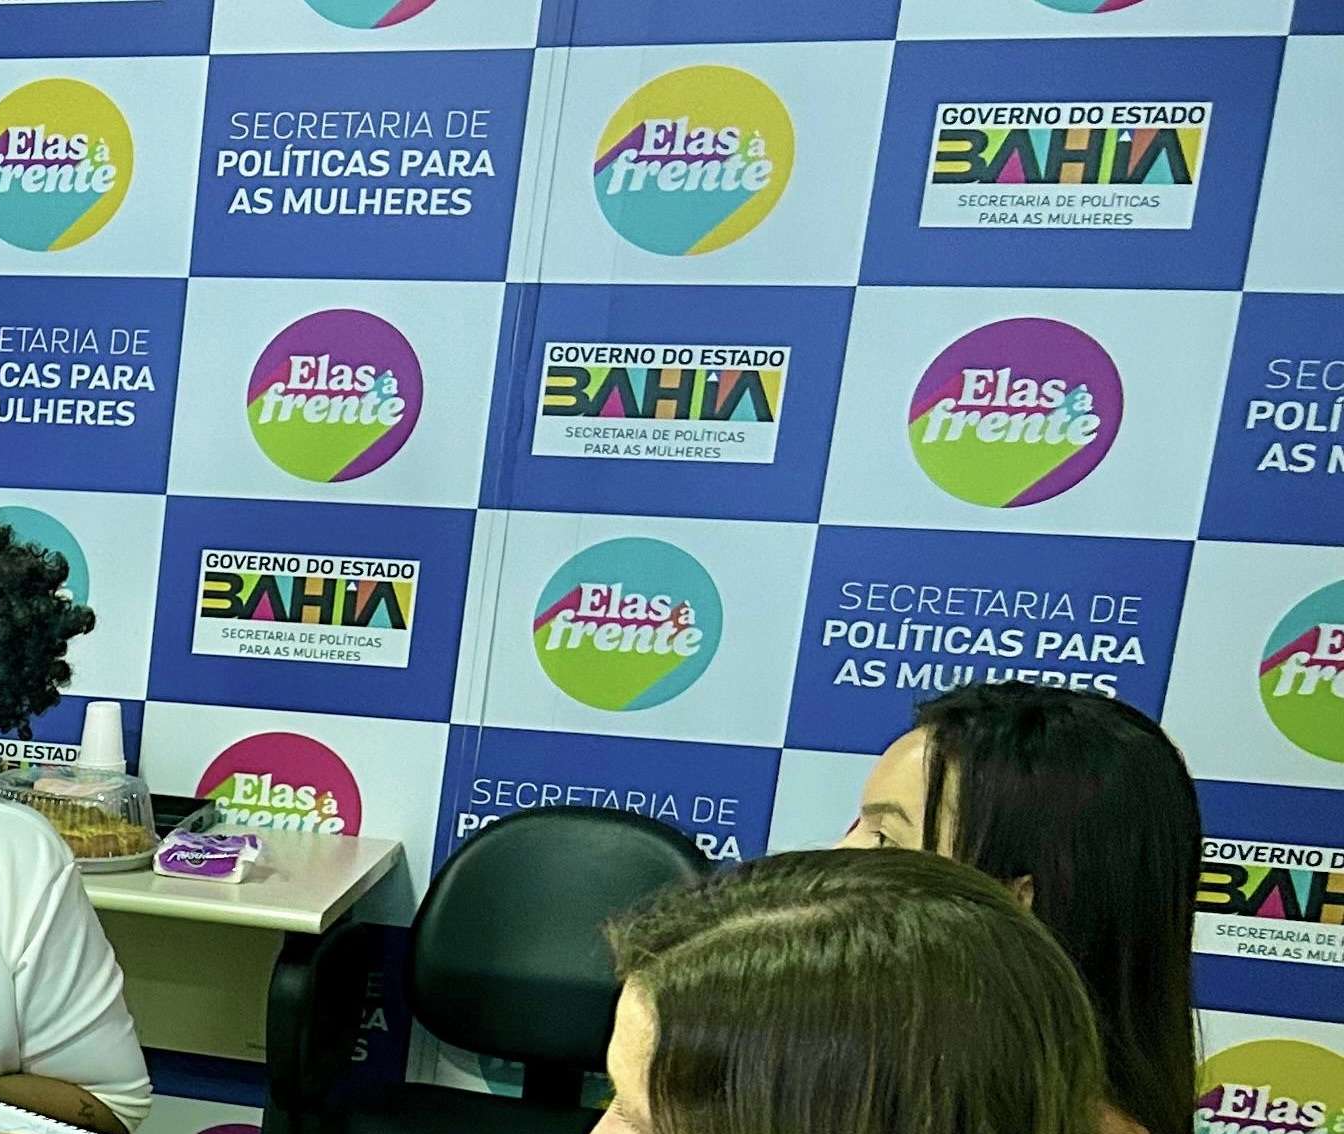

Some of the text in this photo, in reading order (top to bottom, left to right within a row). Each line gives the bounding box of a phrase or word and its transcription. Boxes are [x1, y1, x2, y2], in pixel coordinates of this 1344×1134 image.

[230, 110, 490, 139] SECRETARIA DE
[943, 106, 1205, 125] GOVERNO DO ESTADO
[4, 124, 109, 161] Elas à
[639, 116, 765, 157] Elas à
[217, 144, 495, 176] POLÍTICAS PARA
[931, 128, 1196, 183] BAHIA
[606, 148, 773, 195] frente
[228, 188, 471, 215] AS MULHERES
[958, 193, 1160, 207] SECRETARIA DE POLÍTICAS
[979, 213, 1133, 225] PARA AS MULHERES
[110, 330, 149, 355] DE
[550, 346, 784, 366] GOVERNO DO ESTADO
[71, 364, 155, 391] PARA
[287, 352, 398, 394] Elas à
[543, 367, 777, 420] BAHIA
[956, 366, 1094, 410] Elas à
[257, 384, 405, 425] frente
[566, 427, 744, 443] SECRETARIA DE POLÍTICAS
[922, 398, 1102, 445] frente
[584, 444, 720, 458] PARA AS MULHERES
[1257, 443, 1316, 472] AS
[206, 553, 414, 579] GOVERNO DO ESTADO
[201, 573, 406, 629] BAHIA
[576, 580, 696, 625] Elas à
[840, 582, 1141, 624] SECRETARIA DE
[222, 628, 382, 648] SECRETARIA DE POLÍTICAS
[543, 607, 703, 655] frente
[823, 618, 1145, 664] POLÍTICAS PARA
[239, 644, 360, 661] PARA AS MULHERES
[833, 659, 886, 688] AS
[23, 744, 82, 762] ESTAD
[232, 772, 338, 815] Elas à
[692, 796, 739, 826] DE
[1203, 841, 1323, 868] GOVERNO
[1216, 924, 1334, 944] SECRETARIA DE
[1237, 942, 1303, 959] PARA AS
[1216, 1082, 1327, 1128] Elas
